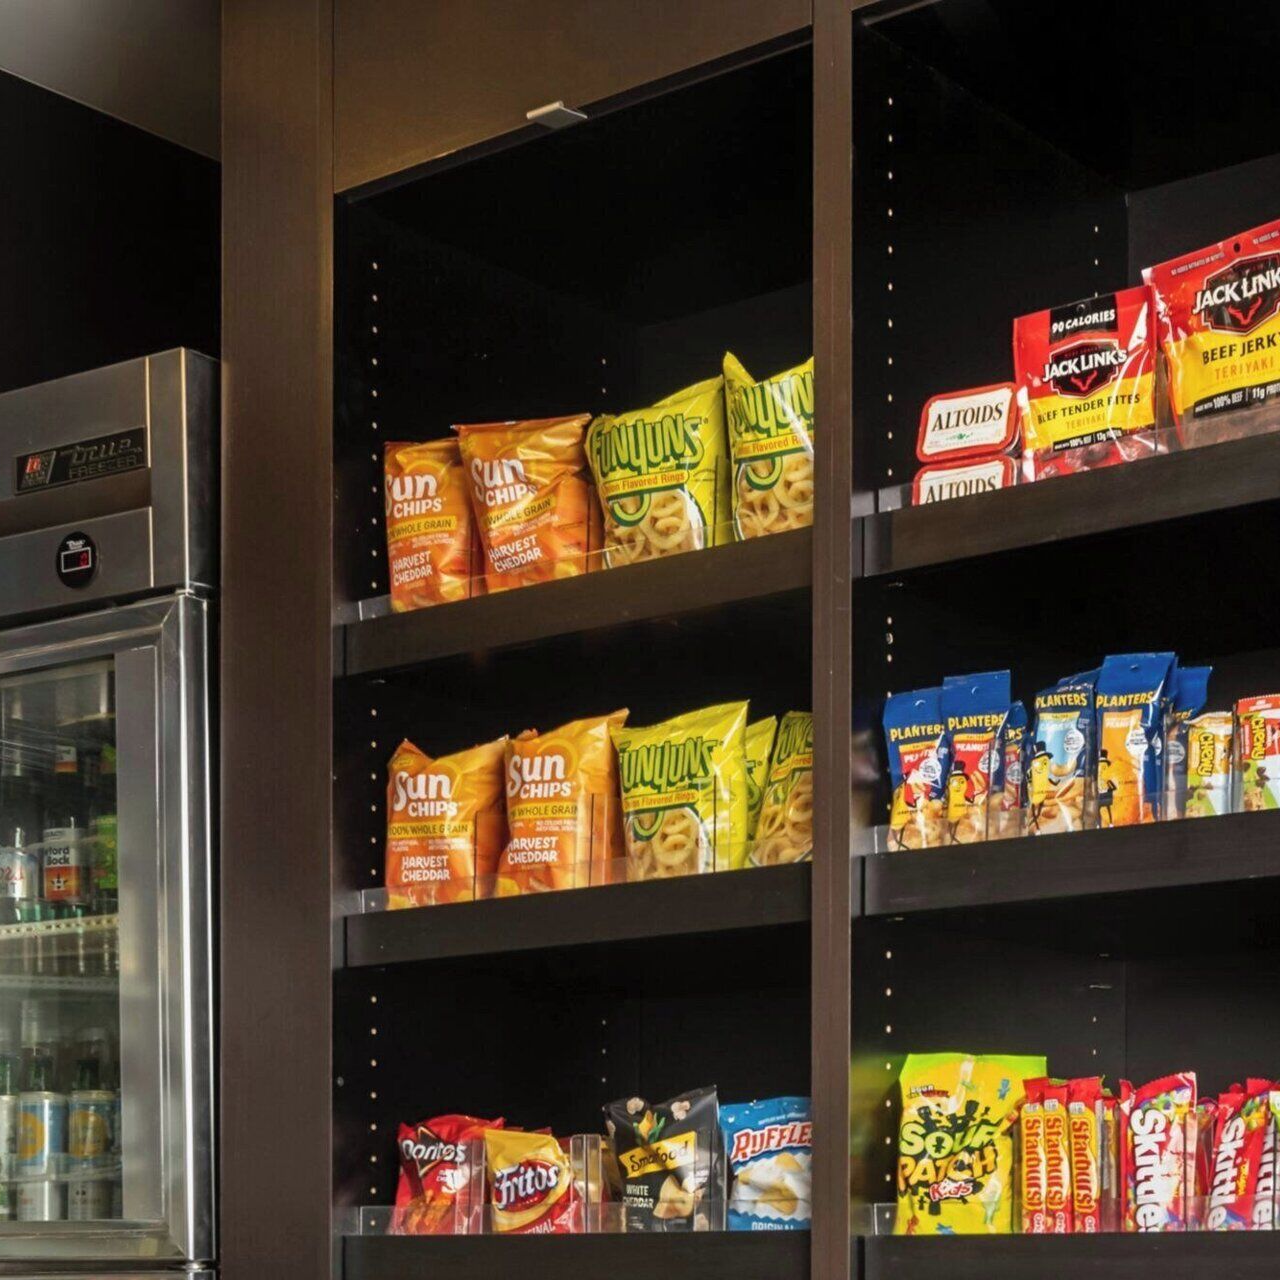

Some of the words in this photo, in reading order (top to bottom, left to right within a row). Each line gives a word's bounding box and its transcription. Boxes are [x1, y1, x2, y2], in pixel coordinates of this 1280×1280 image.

[1192, 280, 1239, 315] JACK
[1052, 320, 1065, 334] 90
[1066, 310, 1116, 330] CALORIES
[1202, 344, 1236, 365] BEEF
[1043, 360, 1080, 382] JACK
[1081, 350, 1128, 370] LINK'S
[1215, 357, 1274, 380] TERIYAKI
[932, 402, 1004, 432] ALTOIDS
[1062, 399, 1104, 418] TENDER
[591, 413, 706, 479] FUNYUNS
[471, 458, 527, 502] Sun
[622, 474, 657, 491] Flavored
[661, 471, 685, 482] Rings
[926, 476, 996, 504] ALTOIDS
[486, 484, 538, 507] CHIPS
[393, 498, 442, 519] CHIPS
[524, 499, 550, 517] GRAIN
[424, 519, 452, 530] GRAIN
[488, 534, 537, 562] HARVEST
[393, 551, 432, 571] HARVEST
[494, 547, 543, 573] CHEDDAR
[393, 565, 433, 586] CHEDDAR
[1036, 693, 1088, 709] PLANTERS
[1096, 691, 1154, 709] PLANTERS
[948, 714, 1005, 730] PLANTERS
[507, 754, 565, 797] Sun
[393, 771, 451, 812] Sun
[520, 782, 572, 799] CHIPS
[408, 801, 458, 817] CHIPS
[518, 805, 548, 816] WHOLE
[411, 824, 437, 835] WHOLE
[439, 824, 468, 834] GRAIN
[508, 836, 558, 853] HARVEST
[401, 855, 448, 870] HARVEST
[507, 850, 559, 865] CHEDDAR
[401, 869, 450, 882] CHEDDAR
[402, 1139, 467, 1163] Doritos
[900, 1122, 999, 1159] SOUR
[898, 1146, 997, 1193] PATCH
[494, 1163, 560, 1210] Fritos
[626, 1184, 649, 1196] WHITE
